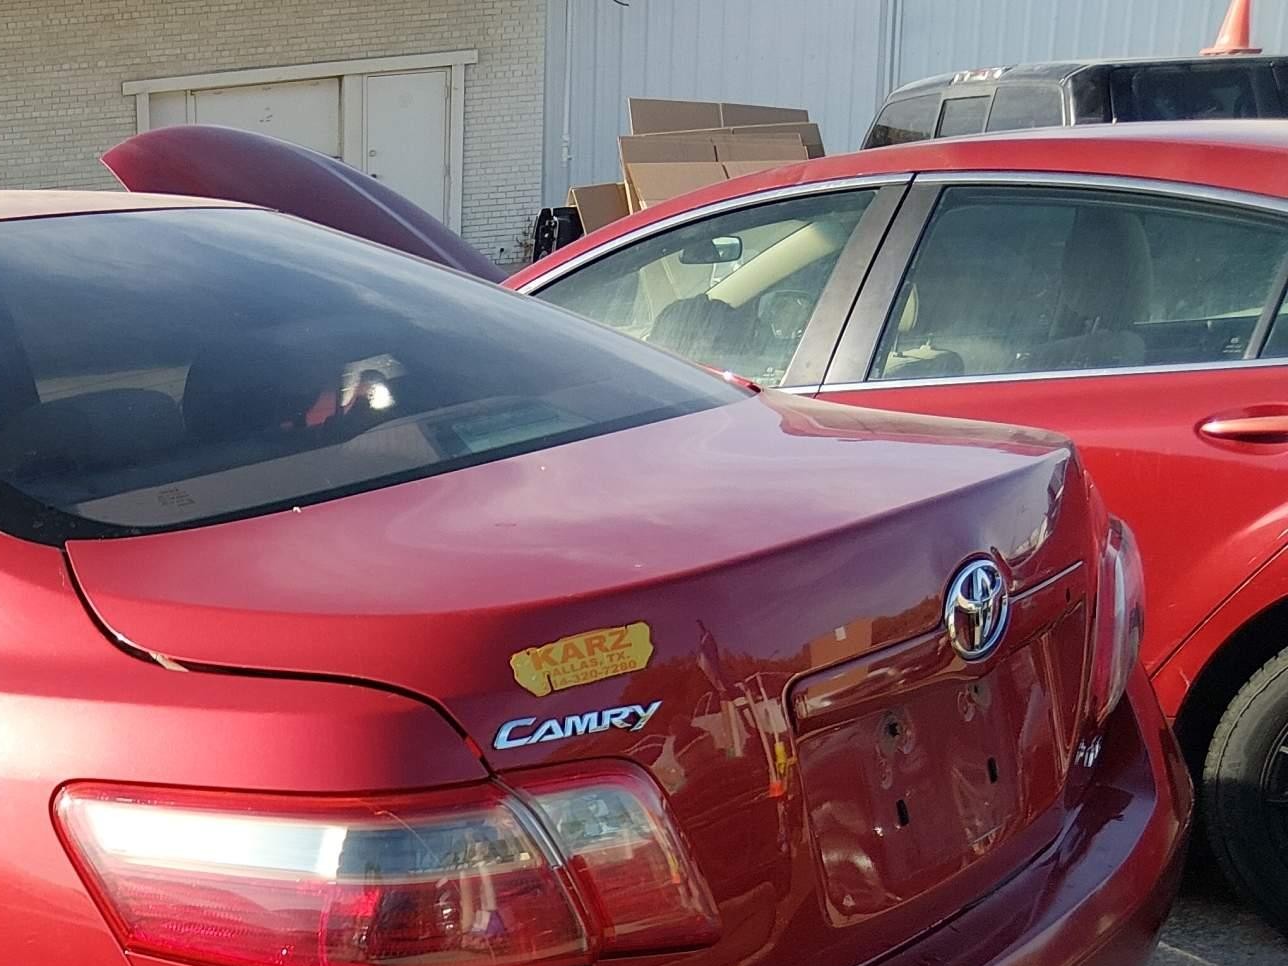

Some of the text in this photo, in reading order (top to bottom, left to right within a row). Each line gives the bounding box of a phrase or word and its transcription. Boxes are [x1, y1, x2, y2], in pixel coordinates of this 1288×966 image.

[530, 629, 633, 671] KARZ
[607, 651, 631, 663] TX.
[545, 660, 637, 689] 14-320-7280
[494, 701, 662, 749] CAMRY
